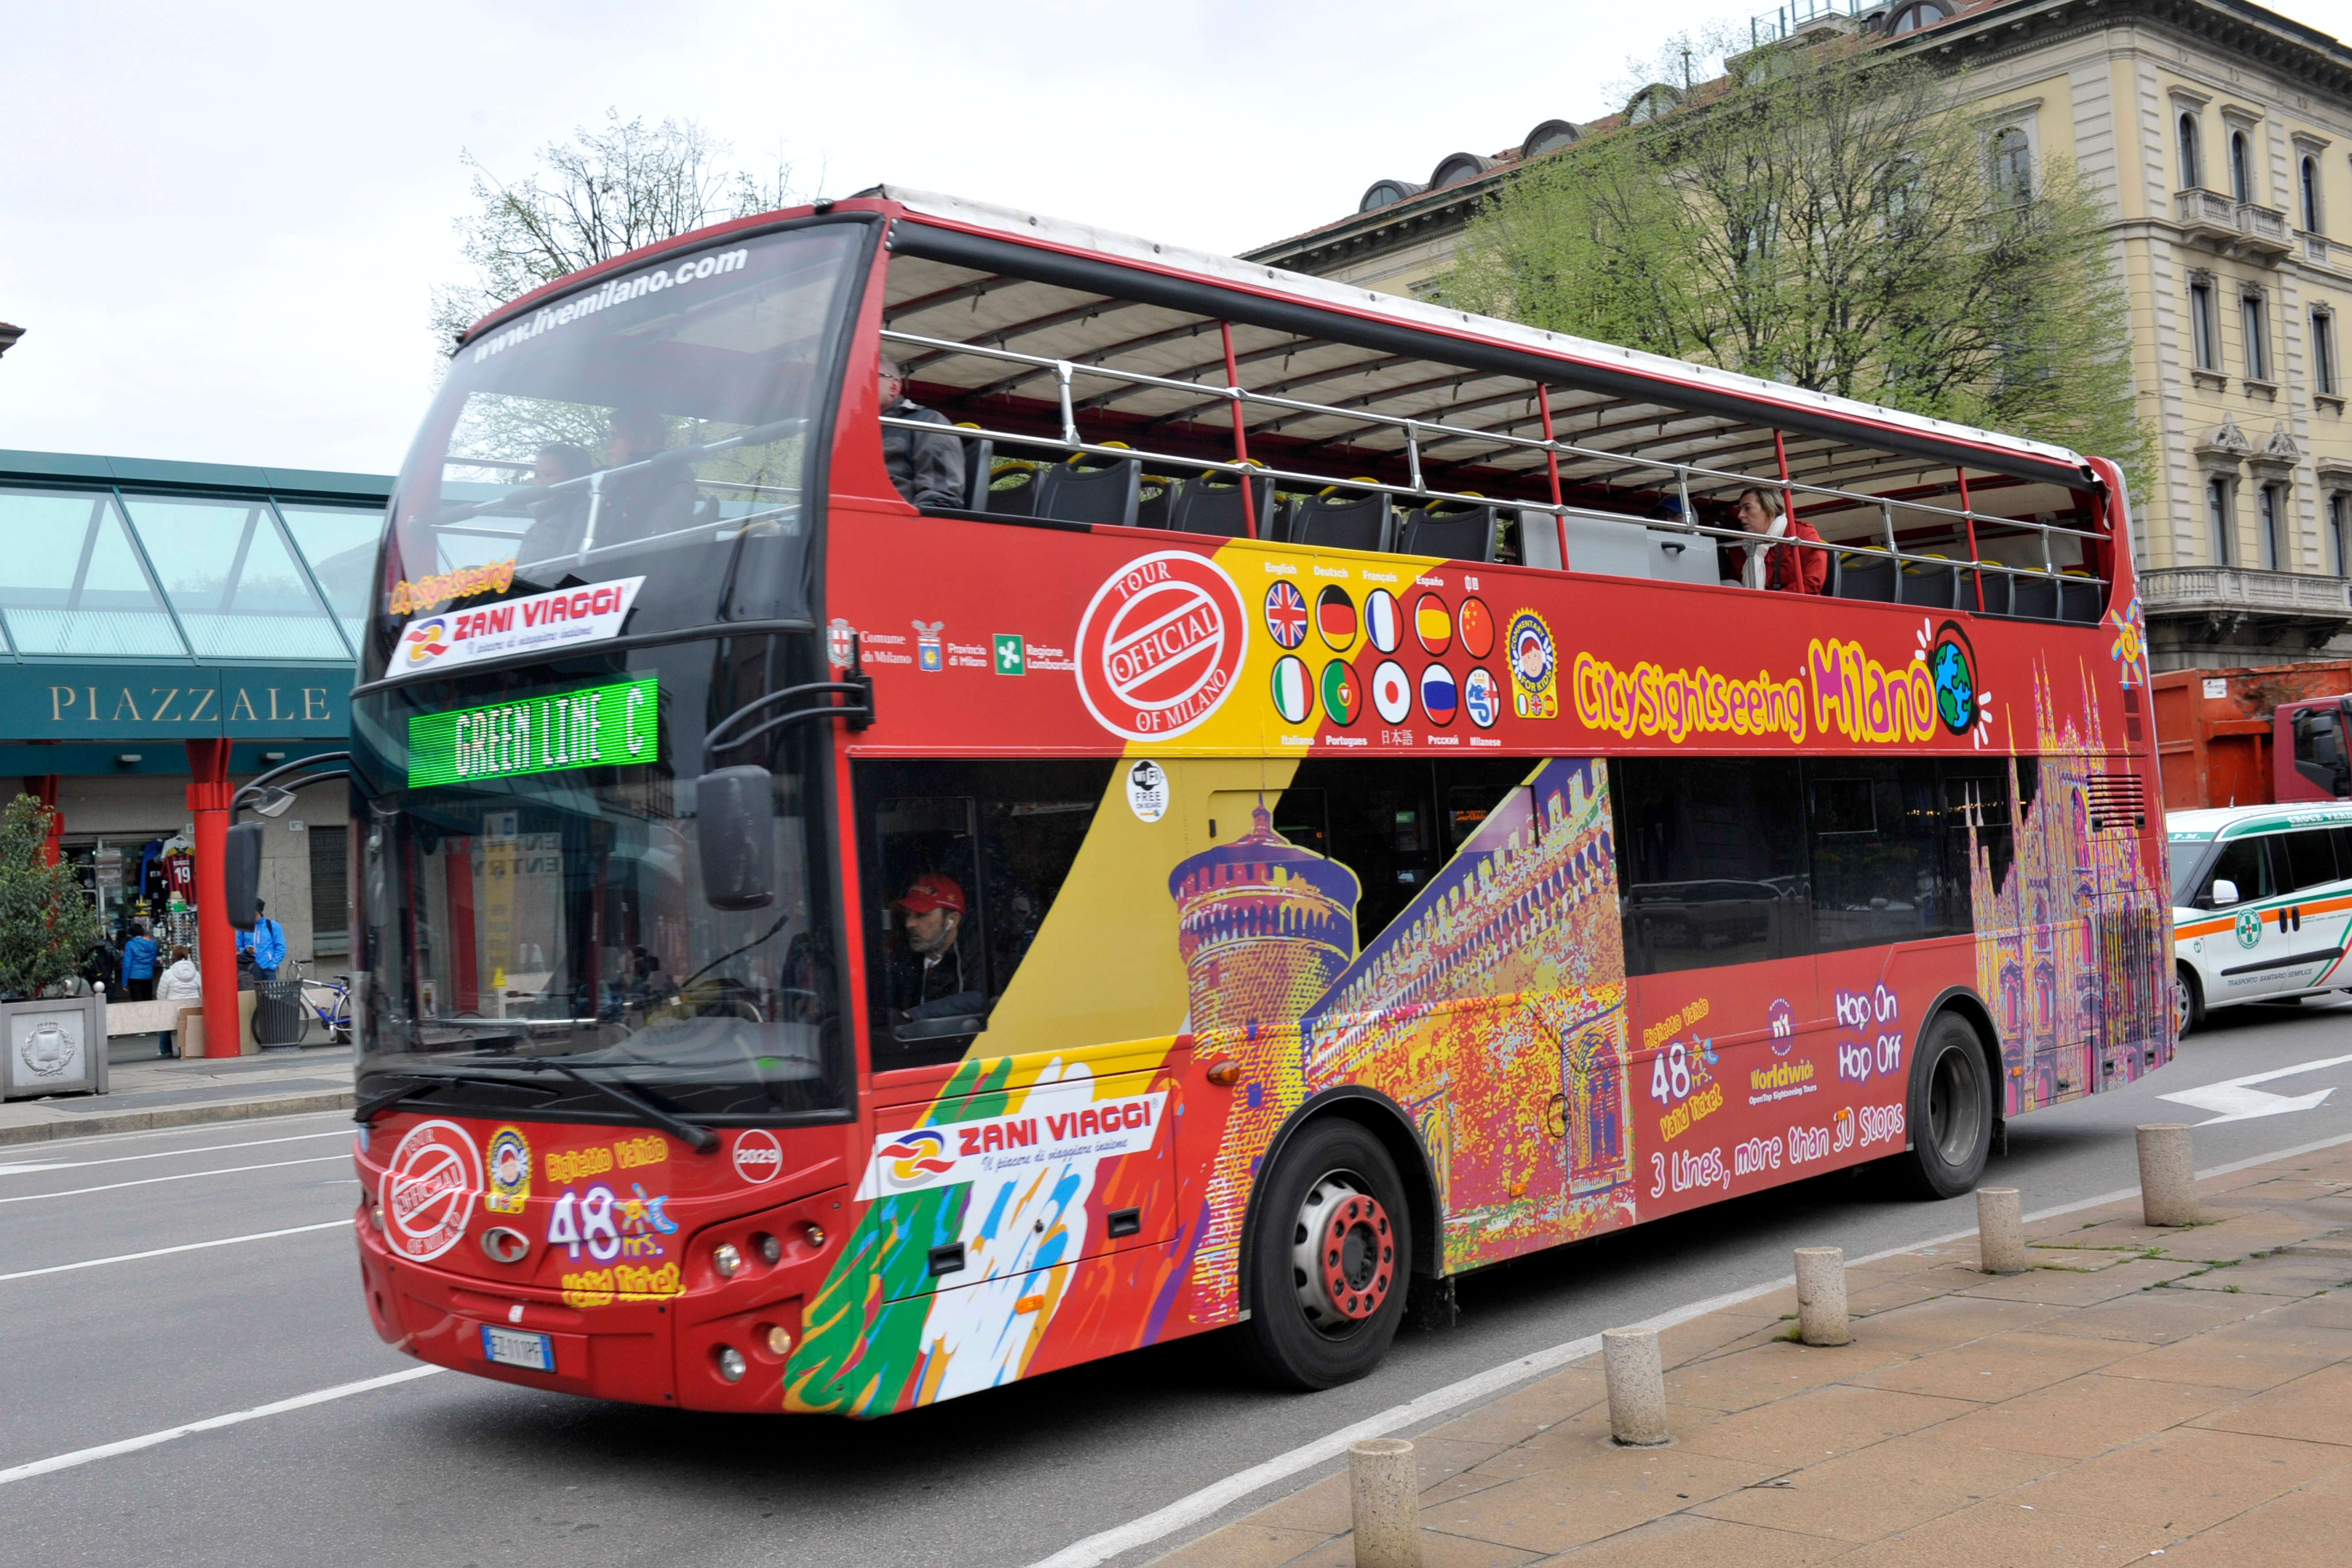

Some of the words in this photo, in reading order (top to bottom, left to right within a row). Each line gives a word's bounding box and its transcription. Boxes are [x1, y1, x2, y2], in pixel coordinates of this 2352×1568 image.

[473, 248, 749, 364] www.livemilano.com
[1114, 561, 1172, 601] TOUR
[1265, 562, 1297, 575] English
[1313, 565, 1349, 578] Deutsch
[1362, 570, 1397, 583] Français
[452, 606, 514, 642] ZANI
[523, 586, 624, 628] VIAGGI
[859, 631, 906, 645] Comune
[947, 643, 986, 655] Provincia
[1111, 606, 1218, 682] OFFICIAL
[1511, 620, 1544, 649] COMMENTARY
[861, 651, 873, 663] di
[874, 651, 912, 664] Milano
[948, 656, 958, 666] di
[959, 656, 988, 667] Milano
[1026, 644, 1064, 659] Regione
[1521, 675, 1536, 692] FOR
[1536, 668, 1551, 691] KIDS
[1574, 651, 1806, 744] CitySightseeing
[1808, 638, 1937, 743] Milano
[49, 685, 331, 722] PIAZZALE
[1136, 711, 1161, 732] OF
[1166, 668, 1227, 730] MILANO
[455, 705, 531, 776] GREEN
[542, 693, 601, 766] LINE
[626, 686, 643, 756] C
[1281, 735, 1315, 746] Italiano
[1381, 729, 1413, 746] 日本語
[1470, 737, 1501, 747] Milanese
[1136, 791, 1161, 802] FREE
[2287, 814, 2323, 823] CROCE
[2323, 811, 2352, 821] VERD
[174, 867, 190, 884] 19
[2227, 977, 2258, 986] TRASPORTO
[2259, 972, 2286, 982] SANITARIO
[2287, 968, 2313, 978] SEMPLICE
[1836, 992, 1871, 1030] Hop
[1875, 985, 1897, 1021] On
[1644, 1014, 1682, 1050] Biglietto
[1682, 998, 1709, 1026] Valido
[1839, 1044, 1872, 1081] Hop
[1877, 1035, 1901, 1073] Off
[1651, 1042, 1690, 1105] 48
[1751, 1059, 1813, 1090] Worldwide
[1773, 1087, 1802, 1100] Sightseeing
[1803, 1085, 1817, 1093] Tours
[1660, 1102, 1690, 1142] Valid
[1689, 1083, 1723, 1121] Ticket
[959, 1118, 1038, 1157] ZANI
[1045, 1101, 1150, 1140] VIAGGI
[545, 1148, 613, 1184] Biglietto
[614, 1135, 668, 1169] Valido
[736, 1149, 777, 1163] 2029
[1651, 1152, 1665, 1198] 3
[1671, 1148, 1730, 1190] Lines,
[1735, 1137, 1782, 1177] more
[1788, 1126, 1828, 1164] than
[1859, 1103, 1904, 1147] Stops
[423, 1212, 460, 1252] MILAO
[548, 1187, 620, 1260] 48
